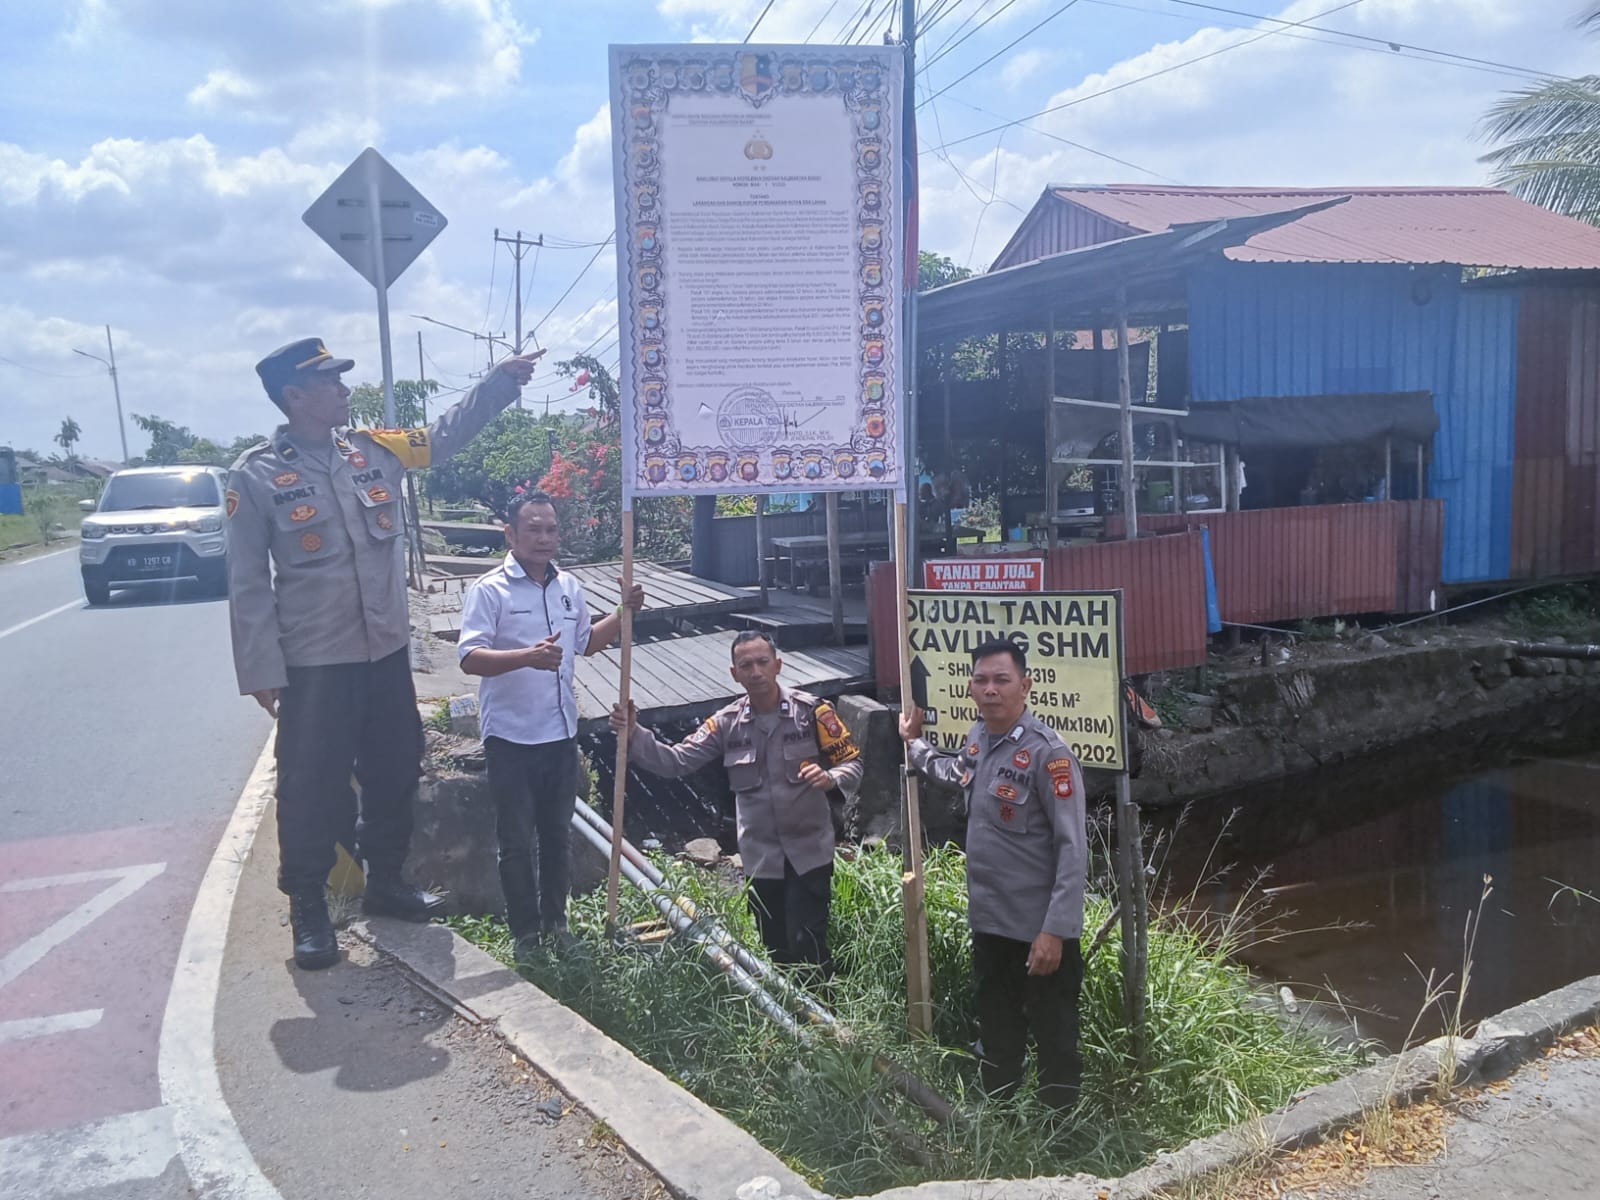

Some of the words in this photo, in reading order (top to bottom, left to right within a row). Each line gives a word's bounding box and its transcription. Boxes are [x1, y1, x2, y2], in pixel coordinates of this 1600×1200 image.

[733, 416, 763, 426] KEPALA
[932, 565, 981, 580] TANAH
[985, 565, 1000, 579] DI
[1003, 564, 1035, 579] JUAL
[942, 581, 971, 590] TANPA
[974, 581, 1026, 590] PERANTARA
[907, 599, 995, 624] DIJUAL
[1000, 600, 1108, 626] TANAH
[1037, 631, 1109, 658] SHM
[1030, 691, 1058, 706] 545
[997, 767, 1030, 786] POLRI
